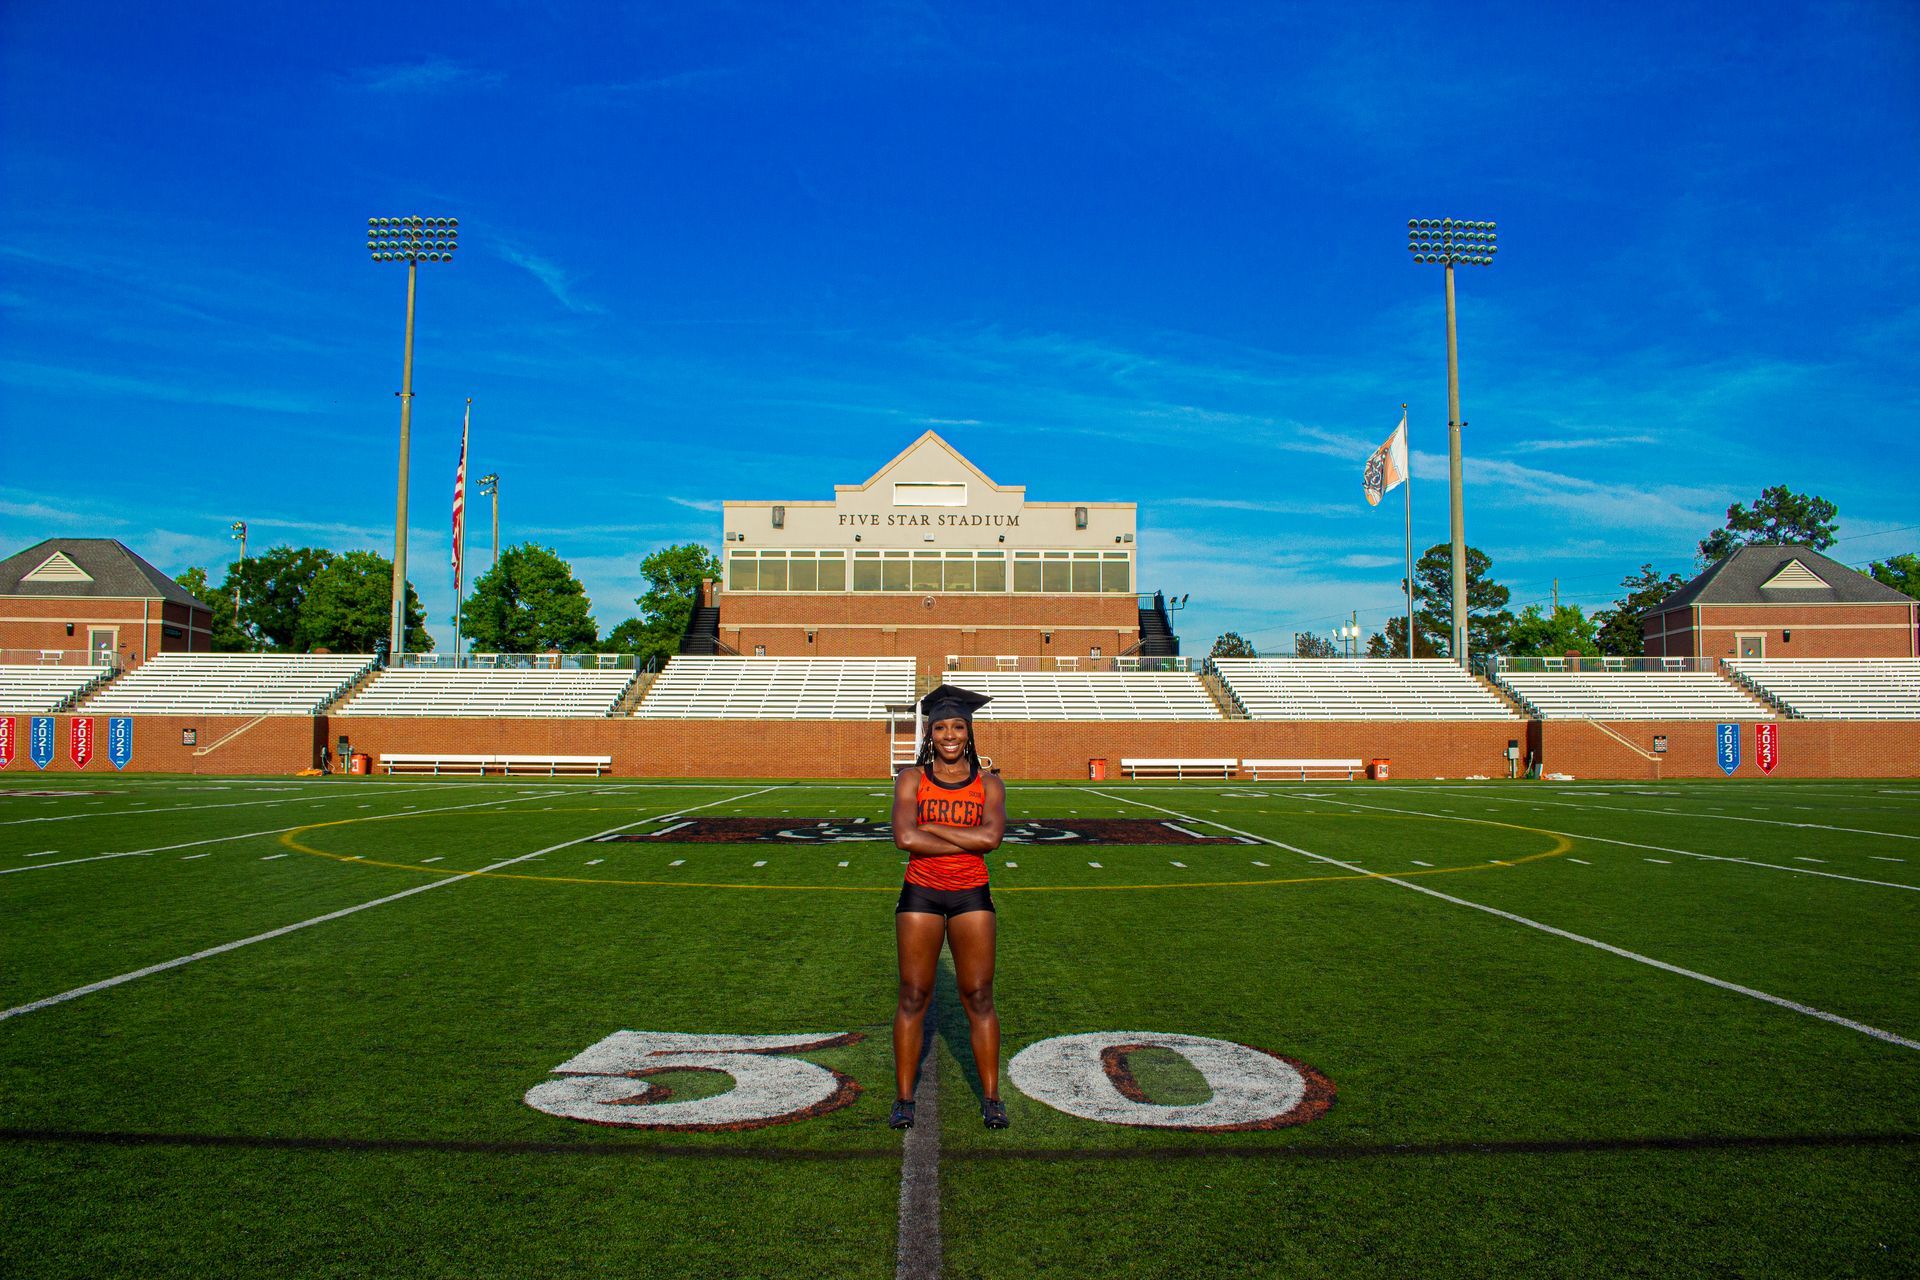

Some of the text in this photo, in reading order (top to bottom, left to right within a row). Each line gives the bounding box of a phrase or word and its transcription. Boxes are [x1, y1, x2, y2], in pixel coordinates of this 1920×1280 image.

[839, 514, 1020, 526] FIVE STAR STADIUM
[38, 718, 48, 756] 2021
[77, 719, 87, 757] 2022
[116, 719, 125, 757] 2022
[1724, 725, 1733, 763] 2023
[1762, 725, 1771, 763] 2023
